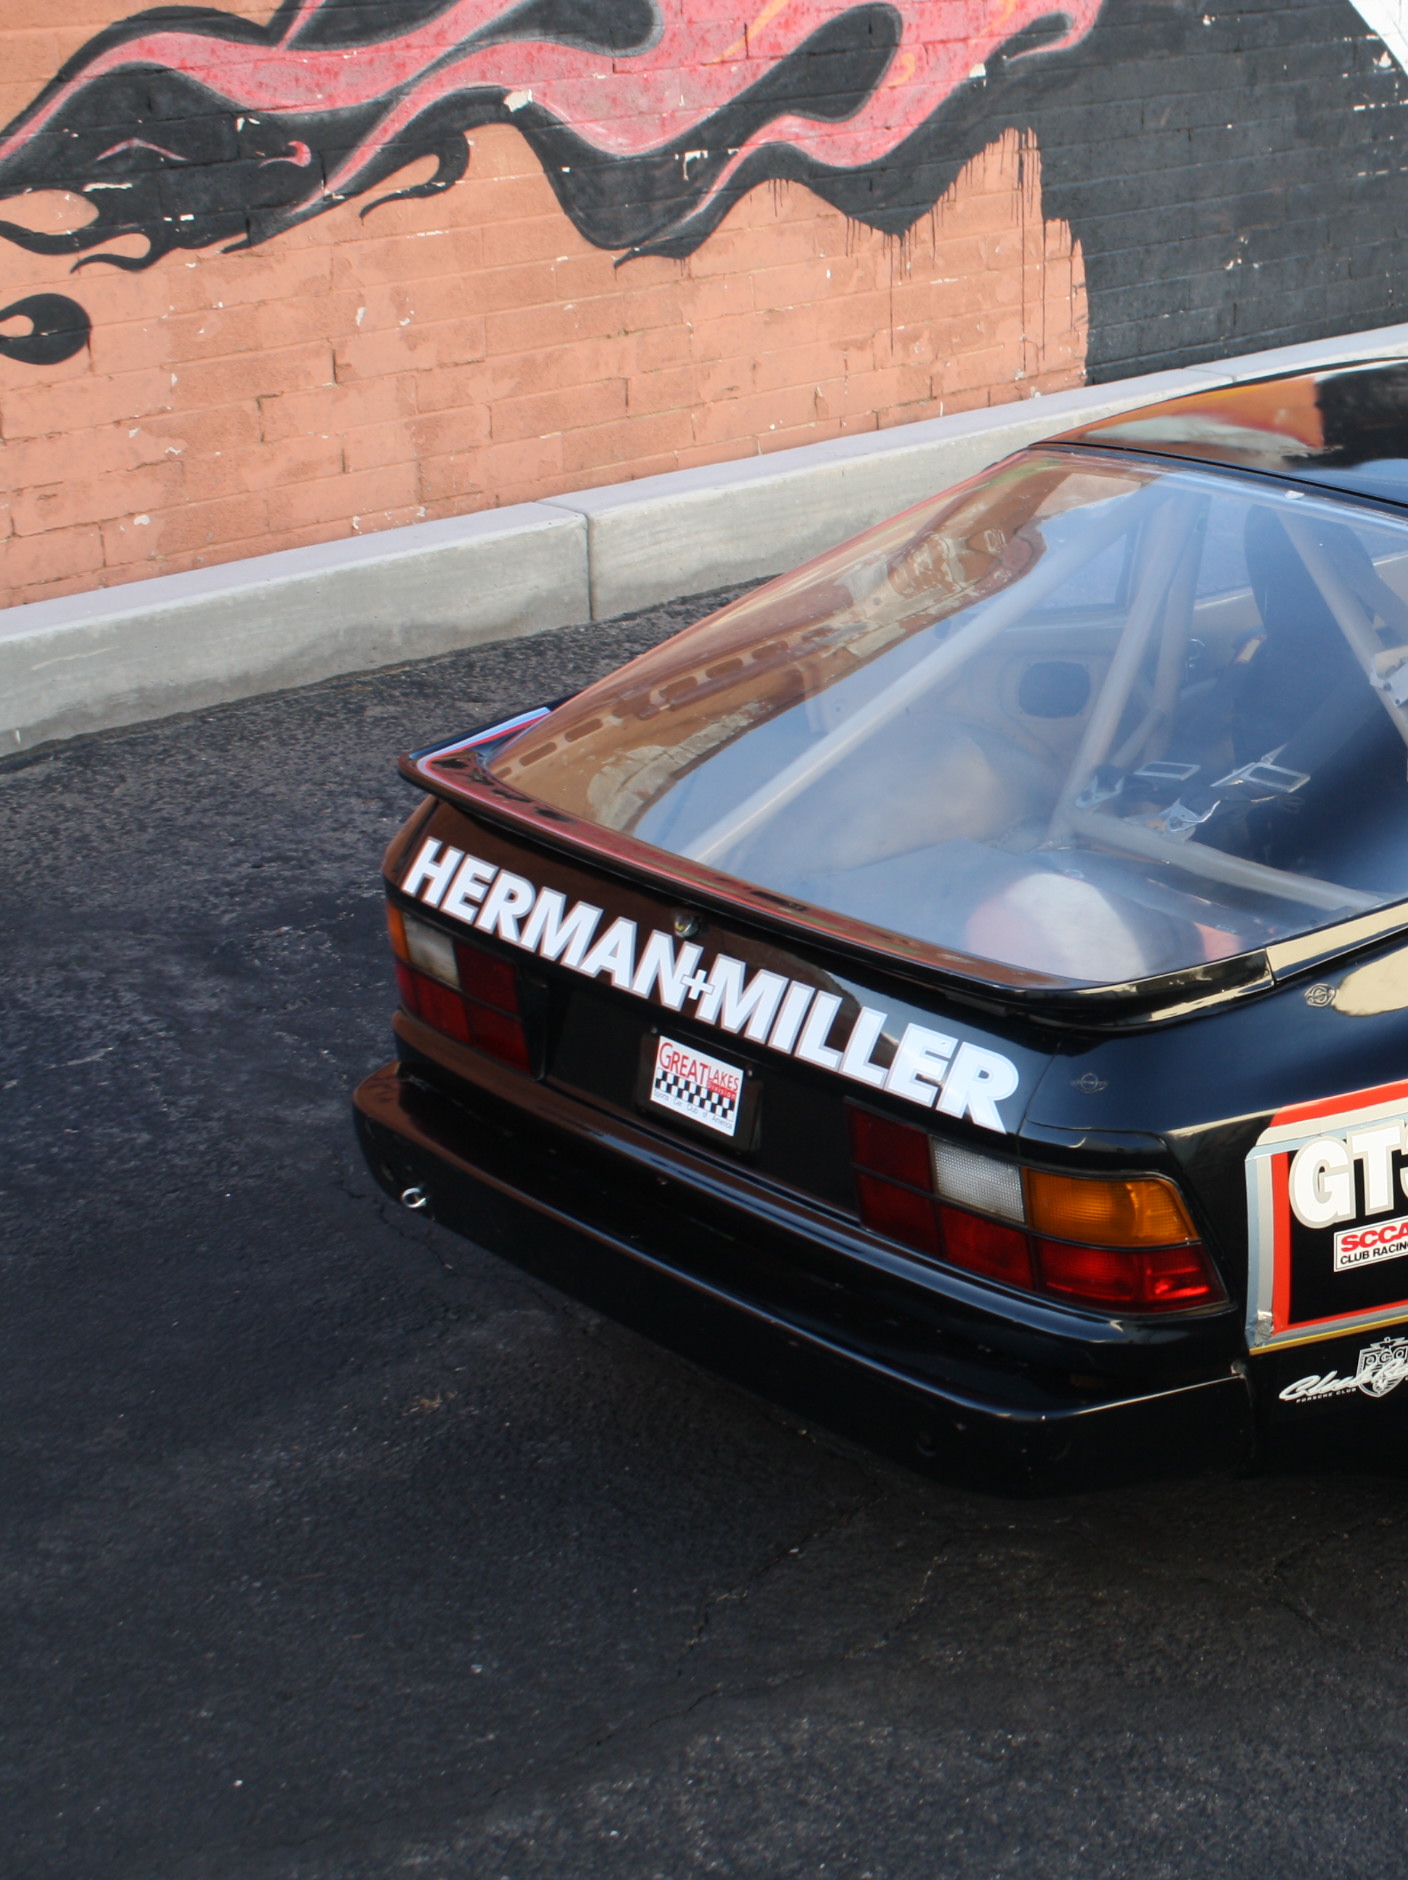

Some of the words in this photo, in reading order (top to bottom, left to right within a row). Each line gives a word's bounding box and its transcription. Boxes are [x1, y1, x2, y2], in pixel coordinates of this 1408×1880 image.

[659, 1042, 709, 1086] GREAT
[708, 1065, 739, 1092] LAKES
[1340, 1250, 1370, 1265] CLUB
[1279, 1362, 1378, 1401] Club
[1296, 1391, 1333, 1404] PORSCHE
[1336, 1387, 1357, 1397] CLUB
